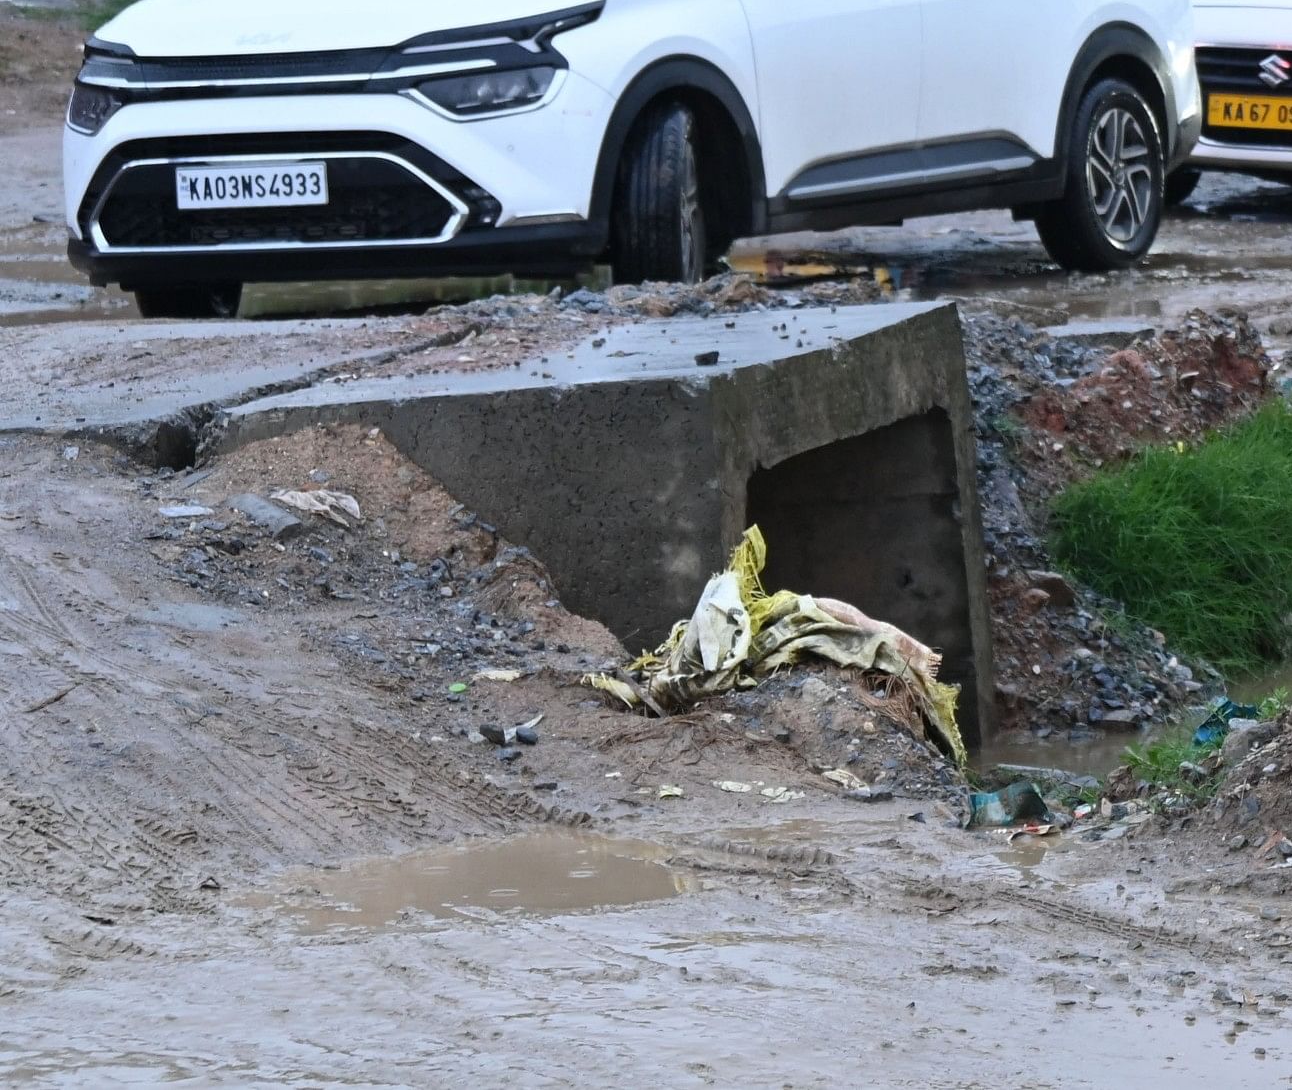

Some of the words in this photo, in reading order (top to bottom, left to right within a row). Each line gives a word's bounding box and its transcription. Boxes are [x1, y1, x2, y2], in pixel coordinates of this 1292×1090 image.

[1223, 103, 1244, 120] KA
[1249, 104, 1271, 121] 67
[189, 172, 321, 201] KA03NS4933
